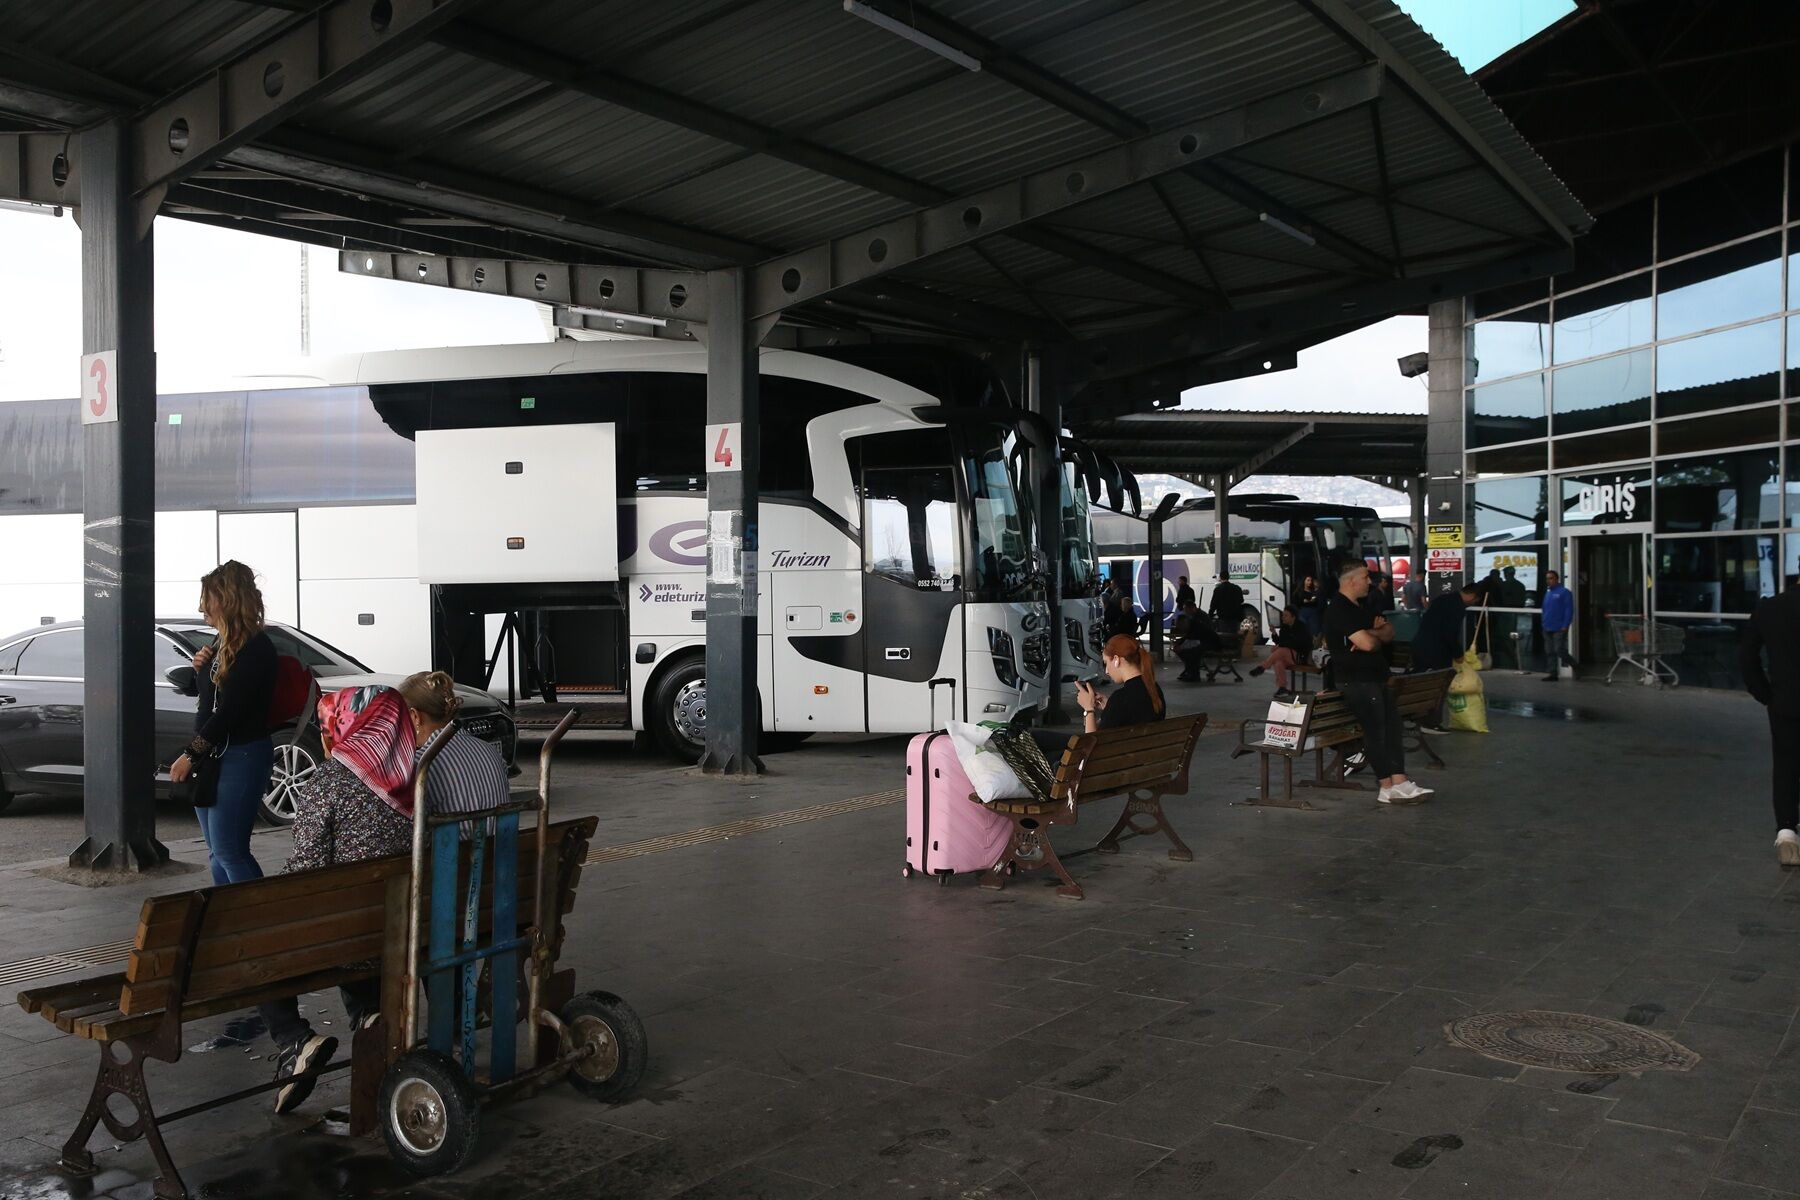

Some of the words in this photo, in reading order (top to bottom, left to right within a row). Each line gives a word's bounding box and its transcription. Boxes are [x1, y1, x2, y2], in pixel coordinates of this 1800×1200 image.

[89, 358, 108, 417] 3
[714, 428, 733, 467] 4
[1579, 476, 1636, 520] GİRİŞ
[771, 549, 831, 568] Turizm
[655, 583, 682, 592] www.
